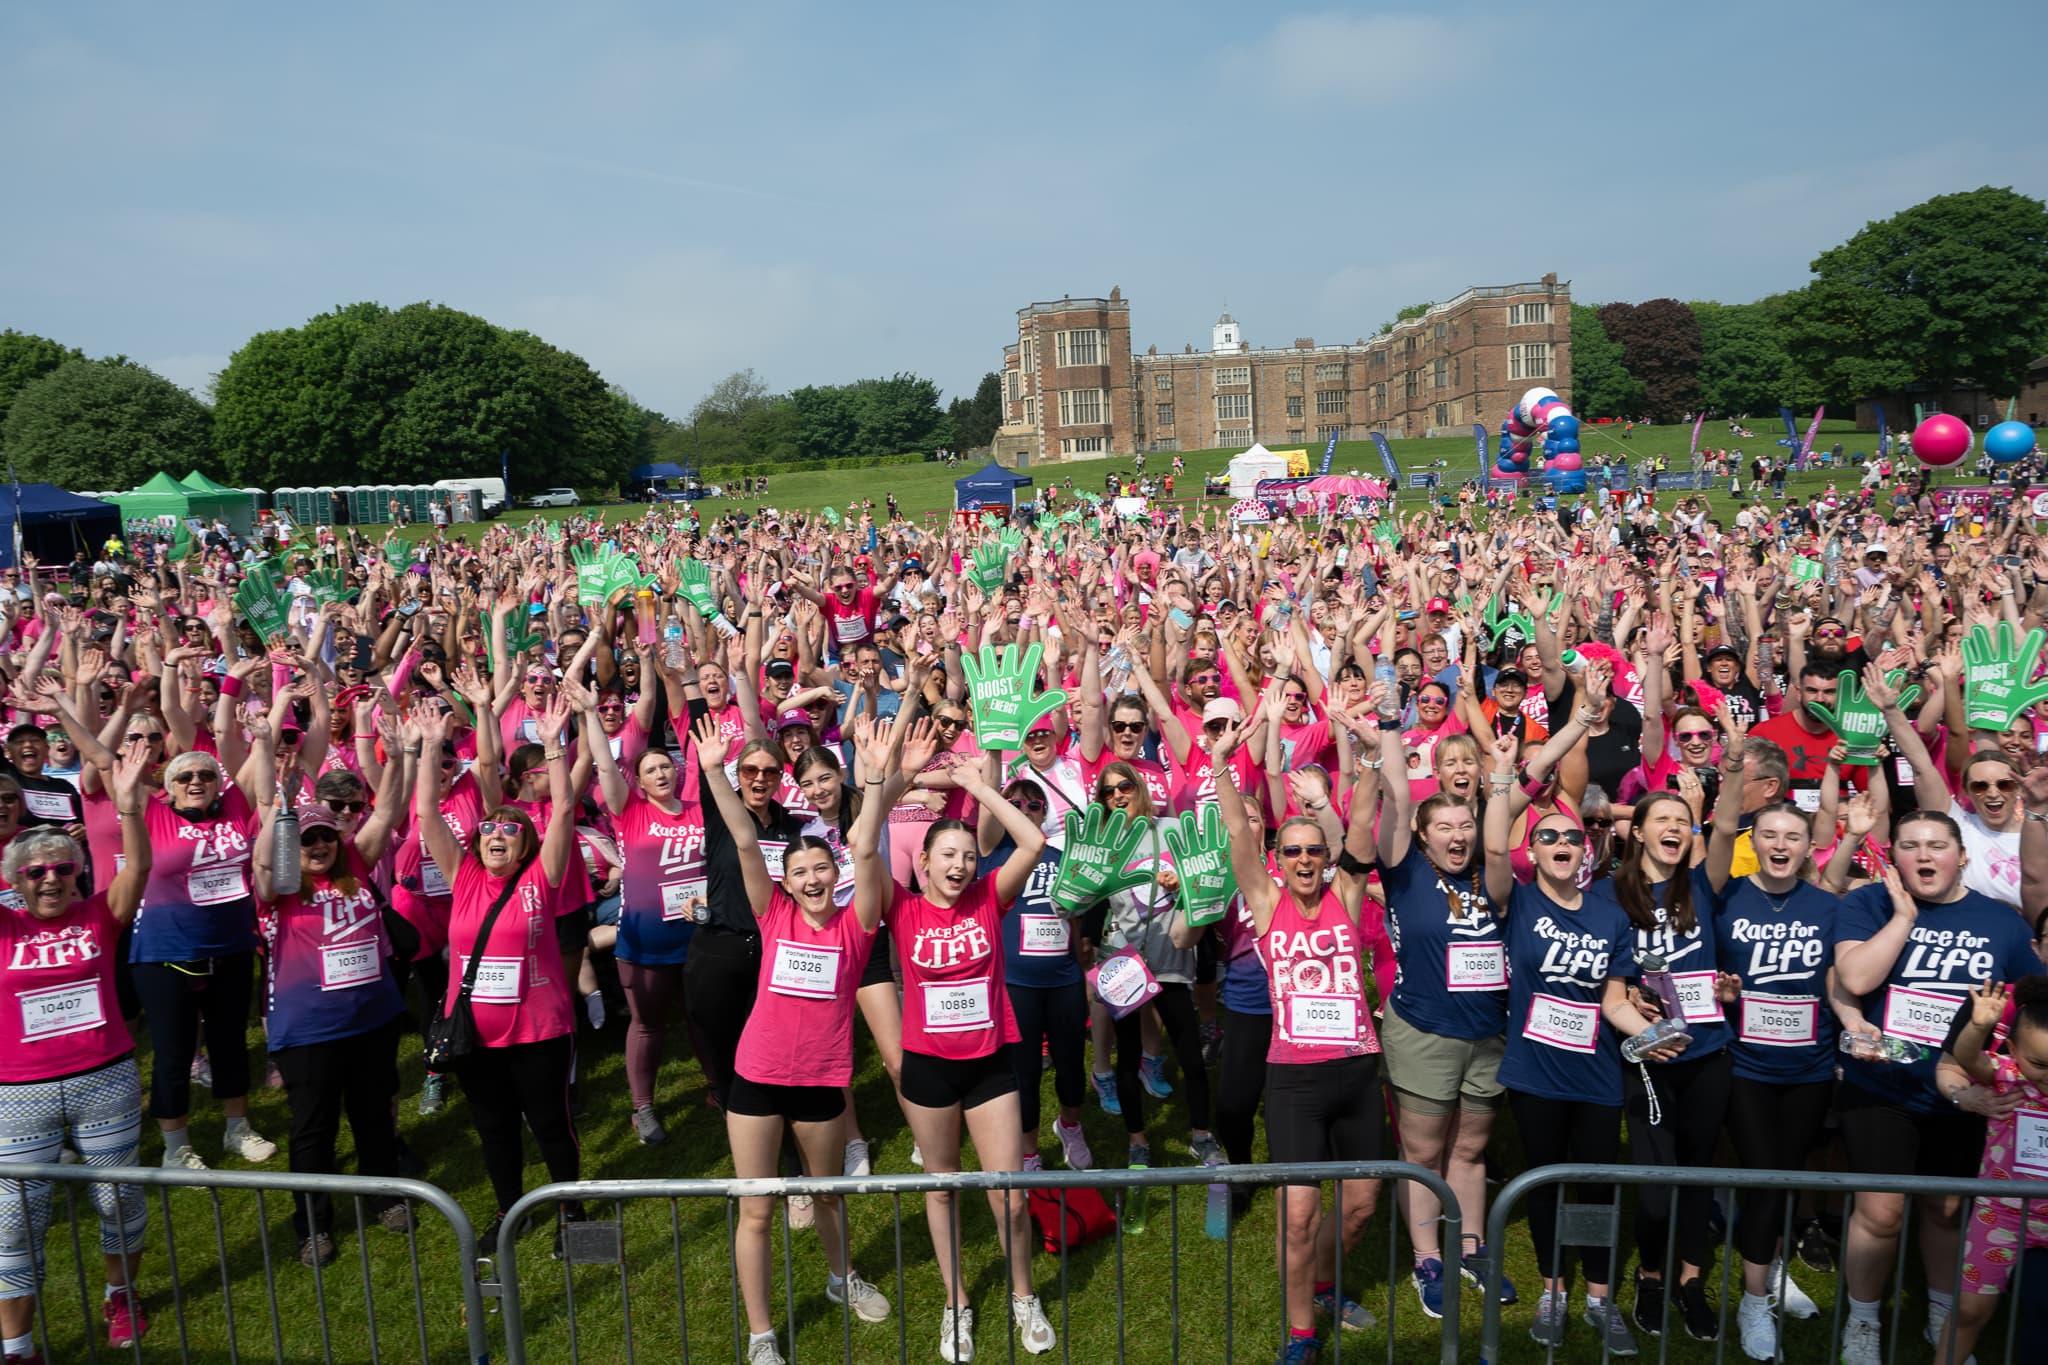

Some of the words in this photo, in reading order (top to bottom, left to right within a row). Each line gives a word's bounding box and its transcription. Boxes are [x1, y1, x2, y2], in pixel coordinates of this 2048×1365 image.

[1971, 663, 2009, 682] BOOST
[977, 677, 1014, 700] BOOST
[990, 698, 1019, 715] ENERGY
[1842, 711, 1875, 733] HIGH
[648, 822, 688, 837] Race
[1070, 843, 1112, 865] BOOST
[1182, 850, 1221, 877] BOOST
[1079, 863, 1108, 885] ENERGY
[953, 917, 978, 936] FOR
[1036, 927, 1062, 937] 10309
[1731, 918, 1787, 943] Race
[1788, 920, 1820, 939] for
[1270, 924, 1354, 959] RACE
[1580, 933, 1608, 950] for
[1908, 926, 1953, 947] ace
[1955, 930, 1990, 949] for
[8, 935, 102, 970] LIFE
[910, 926, 991, 969] LIFE
[338, 954, 369, 968] 10379
[789, 959, 822, 973] 10326
[1465, 960, 1496, 970] 10606
[1539, 941, 1610, 980] Life
[1747, 939, 1823, 976] Life
[1901, 944, 1994, 980] Life
[478, 971, 505, 981] 0365
[1273, 955, 1360, 999] FOR
[941, 999, 976, 1010] 10889
[1678, 991, 1701, 1002] 603
[1906, 999, 1928, 1008] Team
[41, 998, 82, 1014] 10407
[1306, 1009, 1341, 1020] 10062
[1548, 1014, 1584, 1031] 10602
[1761, 1015, 1800, 1027] 10605
[1908, 1008, 1951, 1025] 10604
